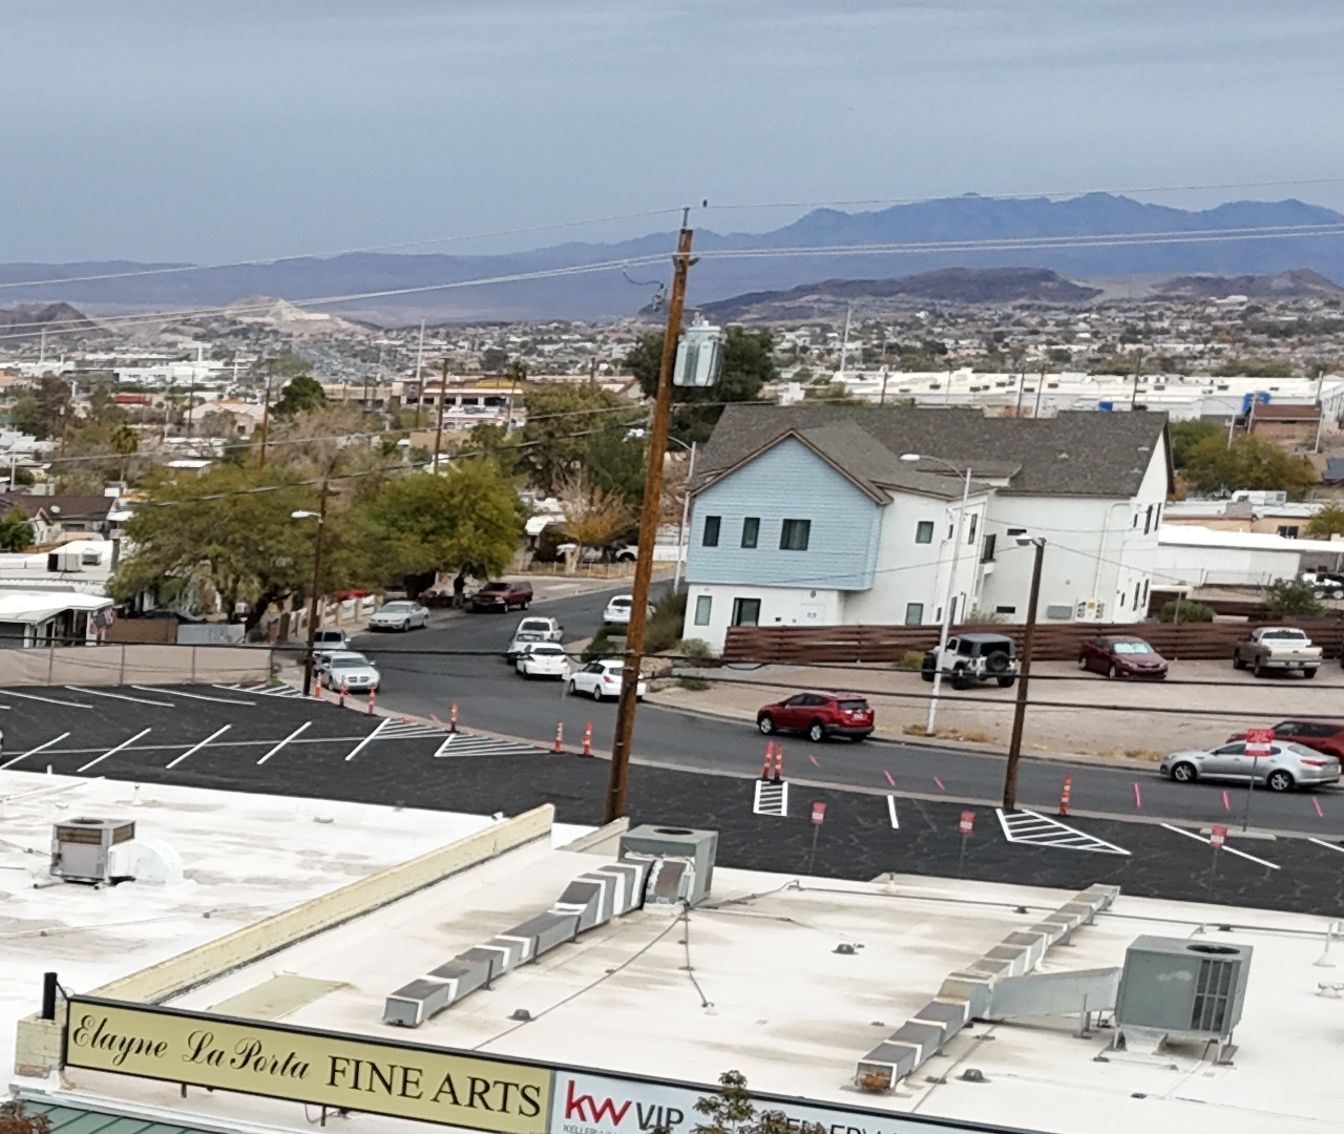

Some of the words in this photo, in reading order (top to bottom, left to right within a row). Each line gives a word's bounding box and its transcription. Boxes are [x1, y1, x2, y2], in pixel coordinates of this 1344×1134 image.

[72, 1014, 169, 1067] Elayne
[325, 1055, 424, 1100] FINE
[430, 1073, 541, 1118] ARTS
[636, 1102, 685, 1131] VIP
